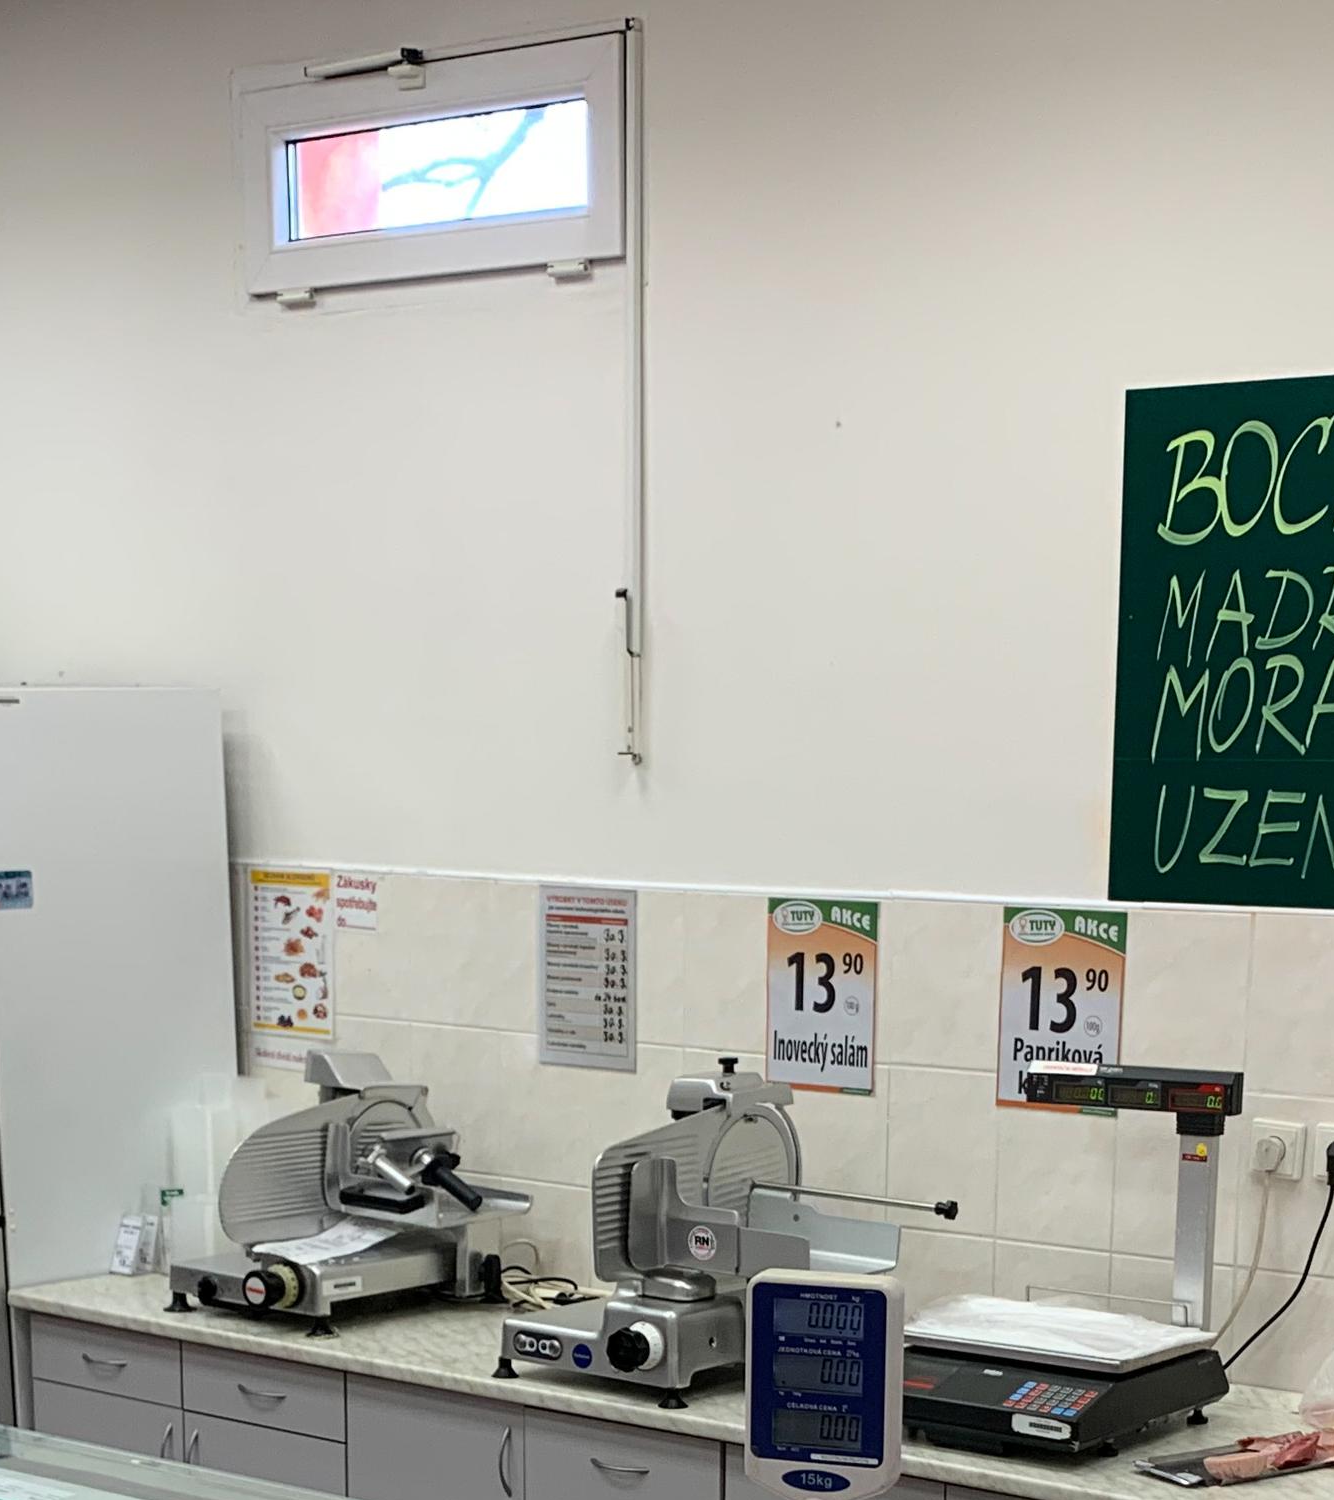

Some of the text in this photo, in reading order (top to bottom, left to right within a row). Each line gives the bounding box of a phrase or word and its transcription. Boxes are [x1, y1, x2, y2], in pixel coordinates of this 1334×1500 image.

[790, 910, 815, 922] TUTY
[830, 906, 871, 931] AKCE
[1028, 917, 1056, 931] TUTY
[1074, 915, 1119, 942] AKCE
[842, 953, 864, 975] 90
[787, 951, 835, 1013] 13
[1085, 969, 1109, 993] 90
[1021, 965, 1078, 1034] 13
[773, 1030, 868, 1071] Inovecký salám
[800, 1472, 833, 1489] 15kg
